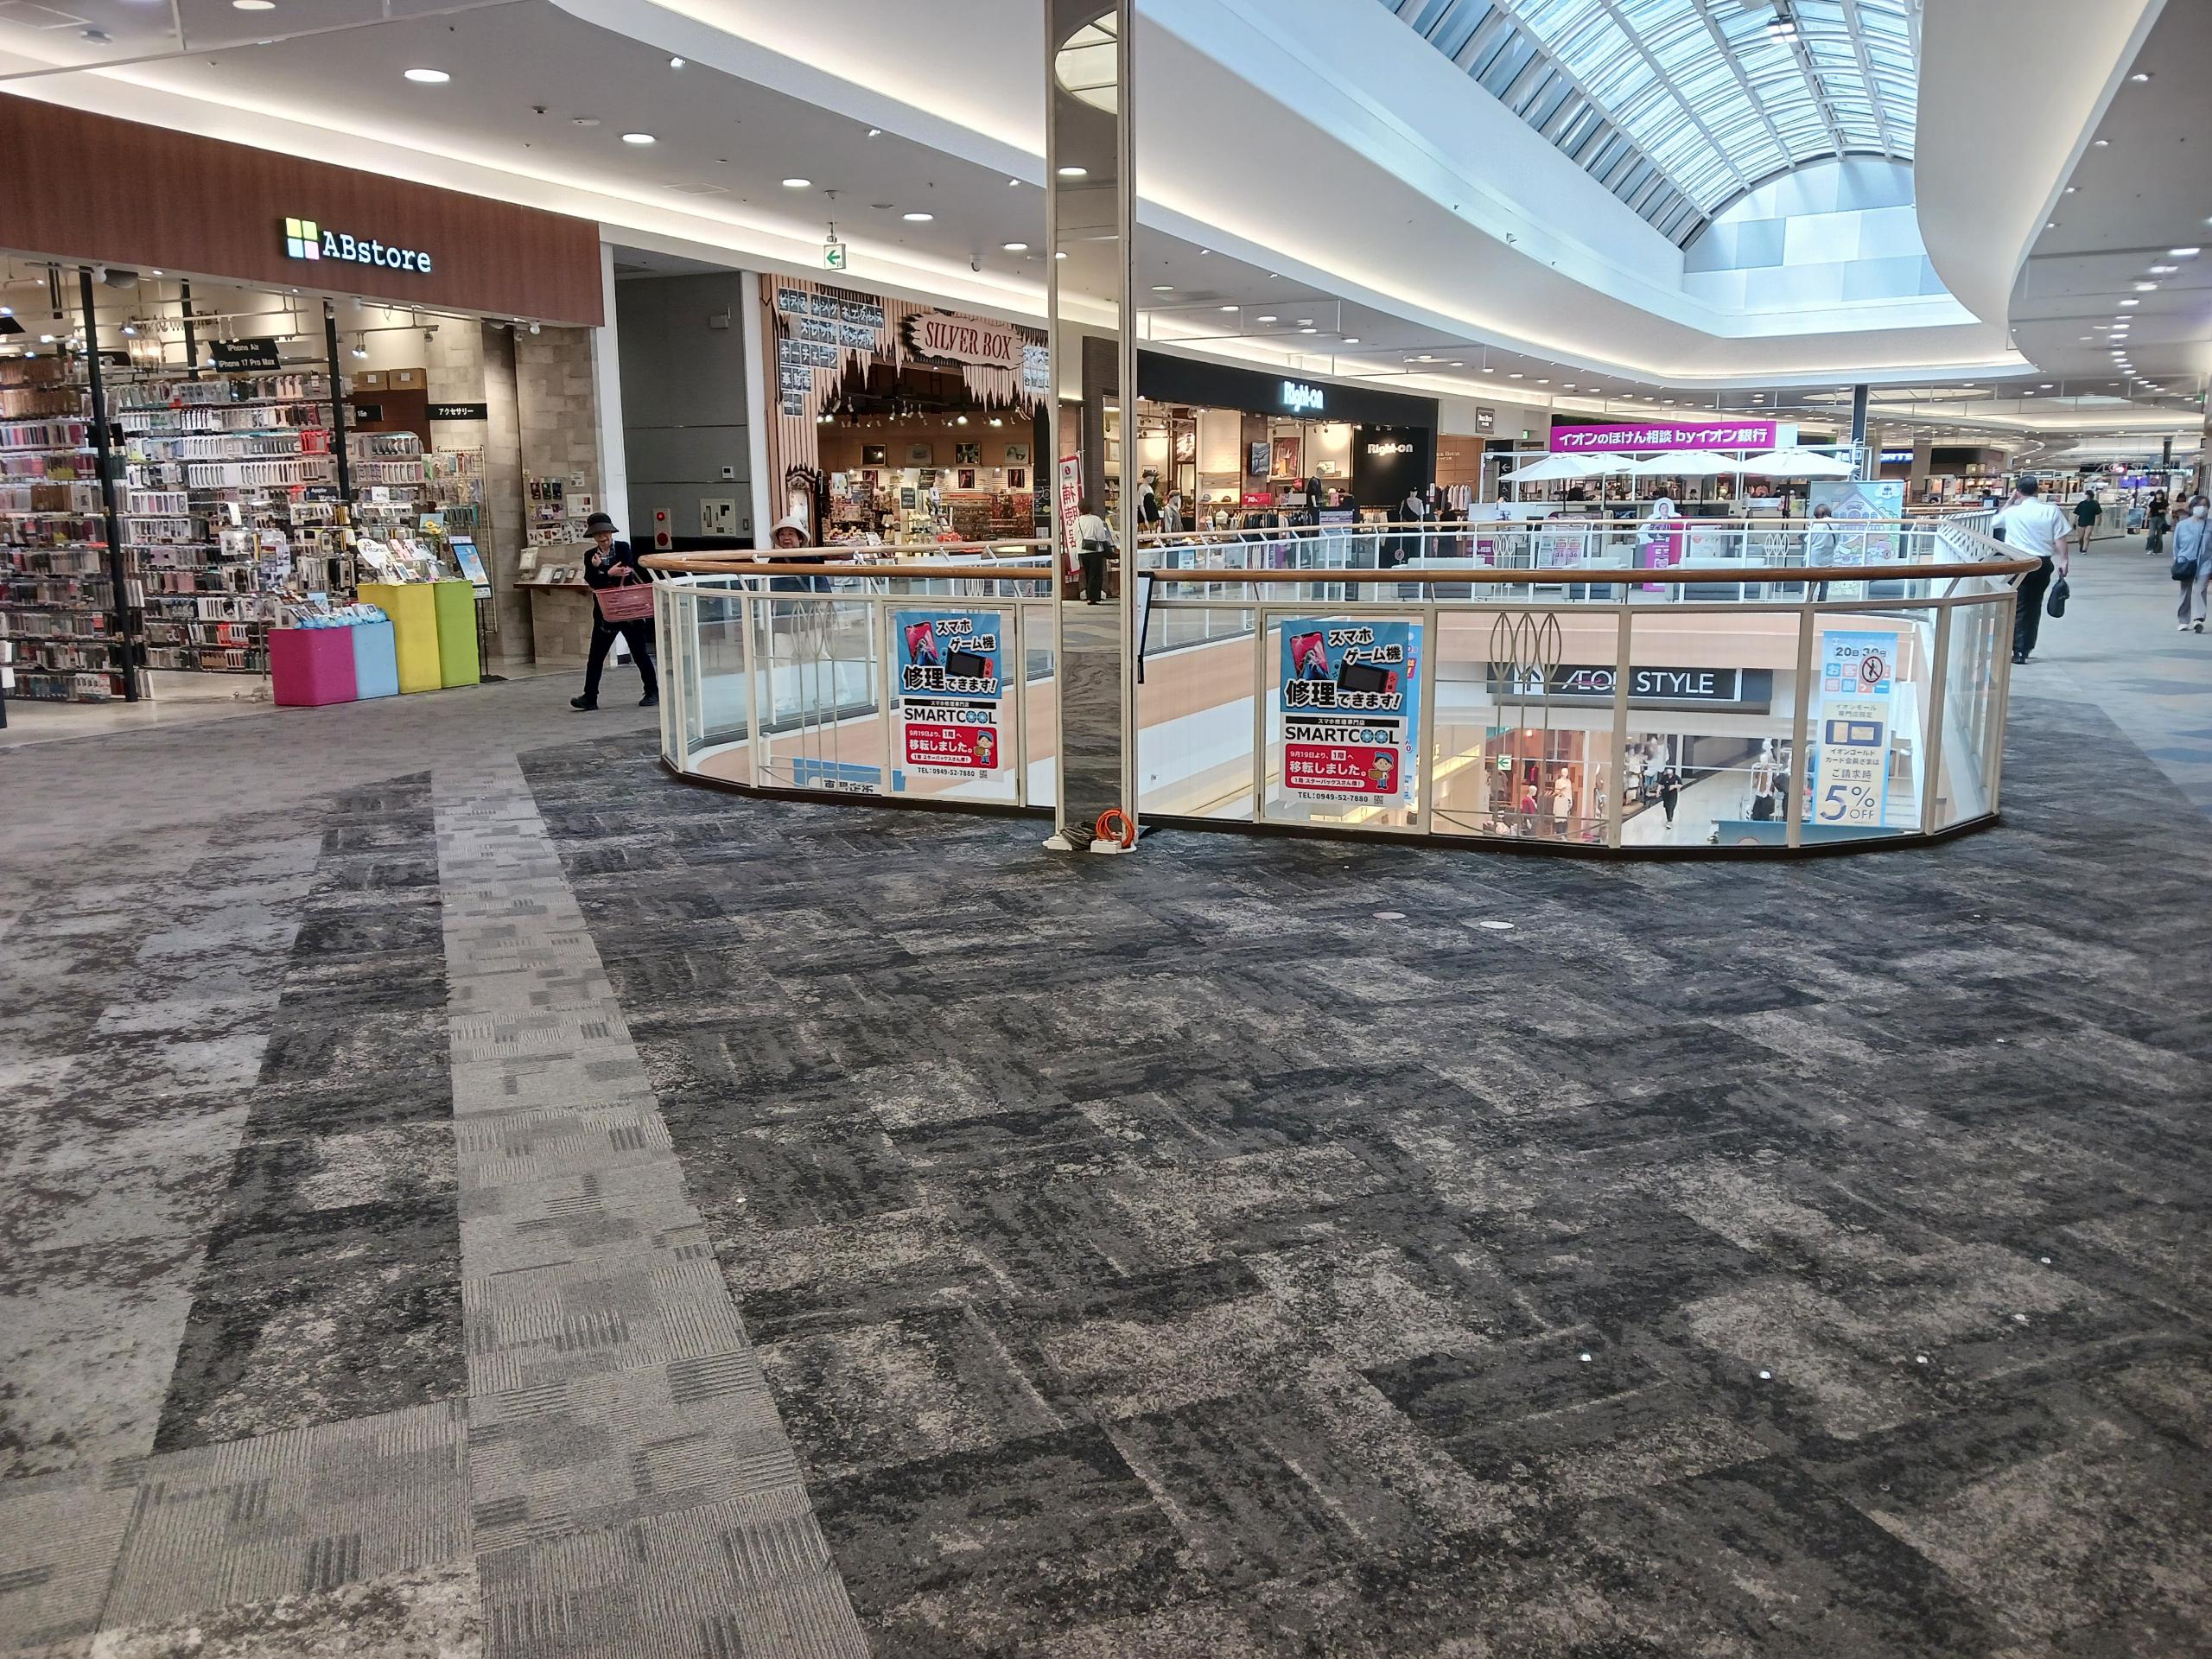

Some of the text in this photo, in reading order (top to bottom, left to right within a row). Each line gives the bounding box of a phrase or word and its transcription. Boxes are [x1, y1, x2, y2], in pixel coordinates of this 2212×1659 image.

[322, 230, 432, 273] ABstore
[925, 321, 1013, 360] SILVER BOX
[1283, 380, 1325, 413] Right-on
[1559, 428, 1768, 447] イオンのほけん相談 byイオン銀行
[1367, 442, 1414, 456] Right-on
[936, 619, 972, 634] スマホ
[950, 634, 996, 652] ゲーム機
[1329, 627, 1373, 645] スマホ
[1344, 645, 1402, 664] ゲーム機
[1835, 646, 1859, 657] 20日
[1636, 671, 1715, 694] STYLE
[904, 708, 997, 724] SMARTCOOL
[1285, 726, 1400, 745] SMARTCOOL
[908, 739, 973, 753] 移転しました。
[1289, 760, 1367, 777] 移転しました。
[1826, 757, 1880, 766] カード会員さまは
[1832, 768, 1872, 779] ご請求時
[1849, 809, 1874, 819] OFF
